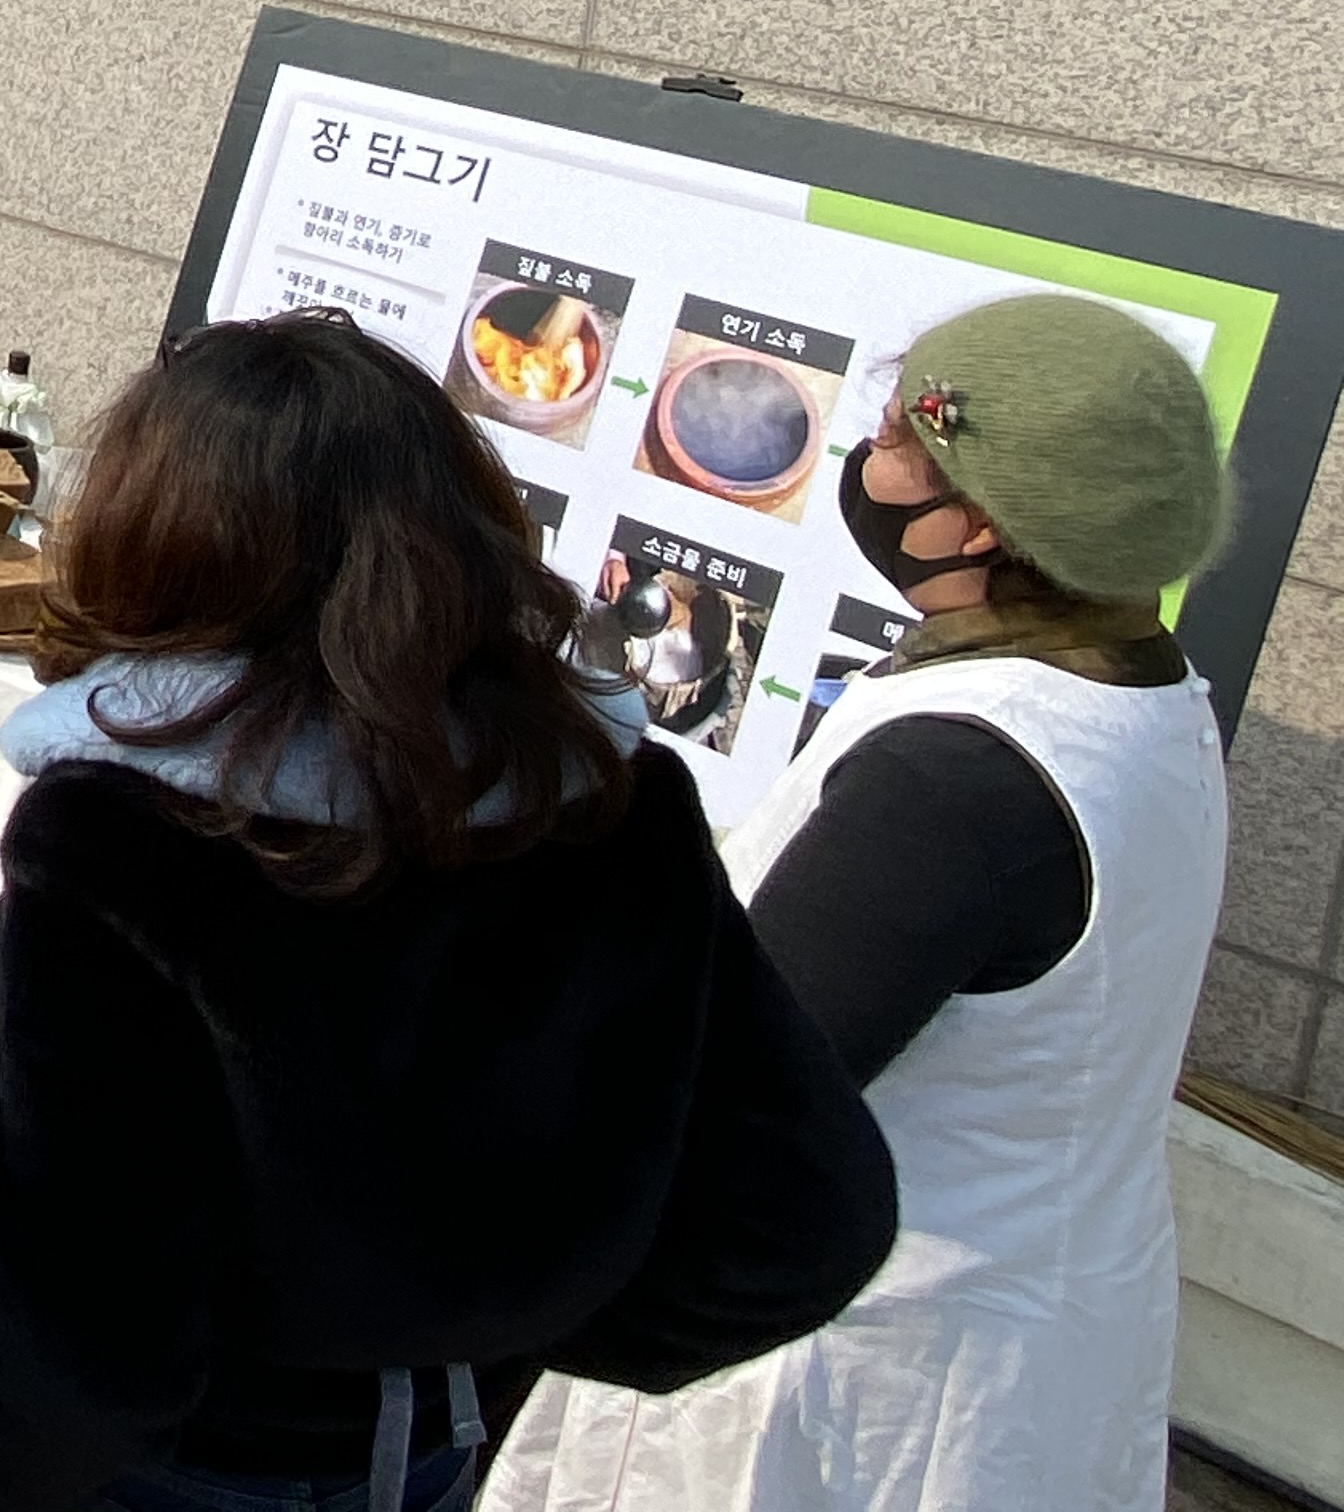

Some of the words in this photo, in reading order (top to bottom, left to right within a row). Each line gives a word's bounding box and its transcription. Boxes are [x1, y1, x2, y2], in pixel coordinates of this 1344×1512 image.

[311, 117, 351, 164] 장
[365, 130, 492, 204] 담그기
[303, 220, 344, 247] 항아리
[345, 234, 404, 265] 소독하기
[287, 269, 327, 296] 메주를
[330, 283, 373, 310] 흐르는
[377, 297, 407, 322] 물에
[554, 268, 593, 295] 소독
[721, 312, 762, 343] 연기
[763, 327, 807, 356] 소독
[641, 535, 701, 573] 소금물
[706, 556, 748, 589] 준비
